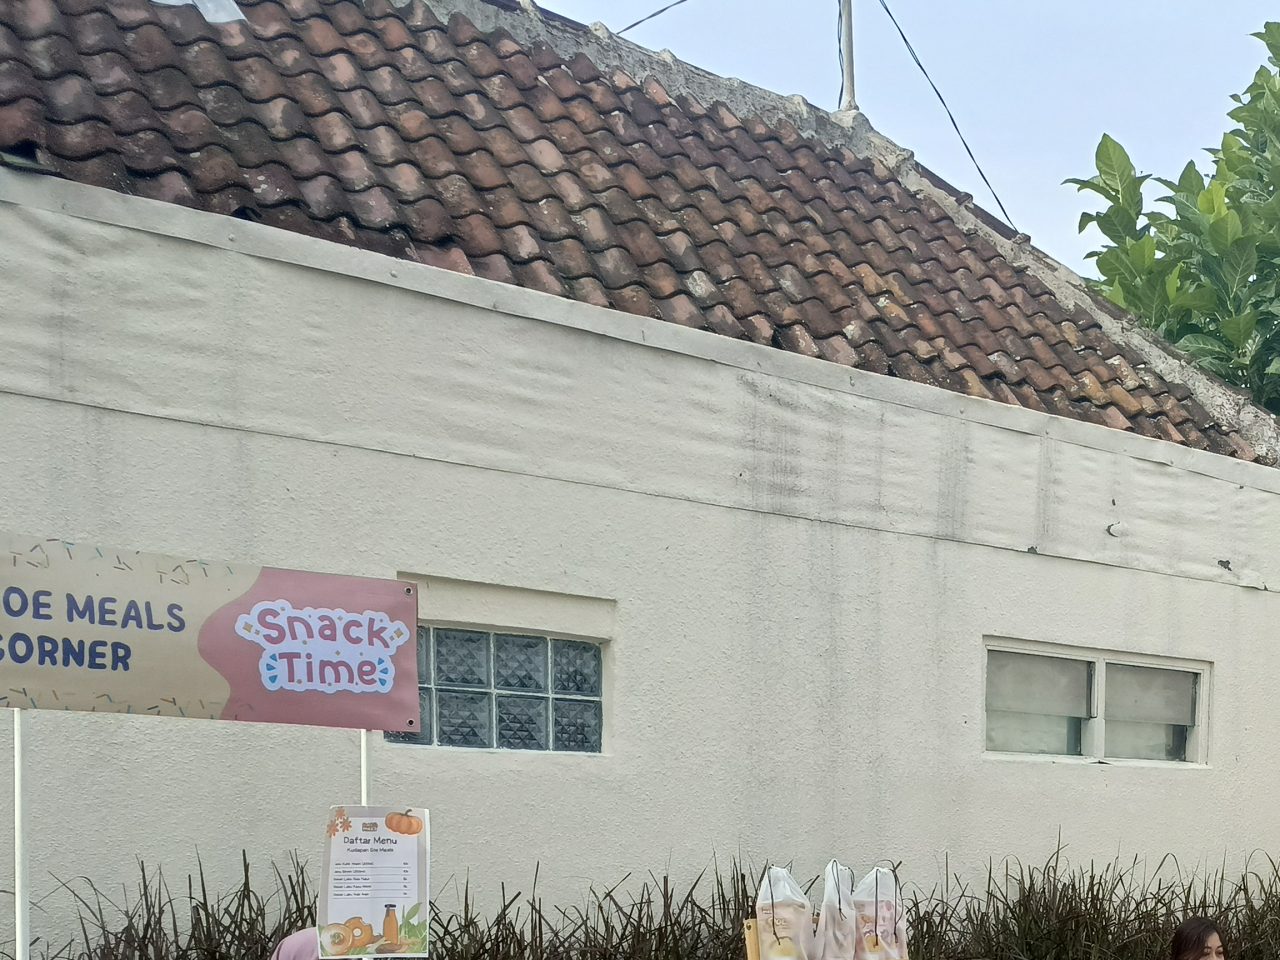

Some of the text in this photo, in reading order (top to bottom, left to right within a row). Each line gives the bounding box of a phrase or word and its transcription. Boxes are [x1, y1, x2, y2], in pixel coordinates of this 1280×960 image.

[2, 586, 186, 633] OE MEALS
[257, 607, 390, 650] Snack
[0, 632, 131, 672] ORNER
[278, 652, 378, 686] Time
[343, 836, 398, 845] Daftar Menu
